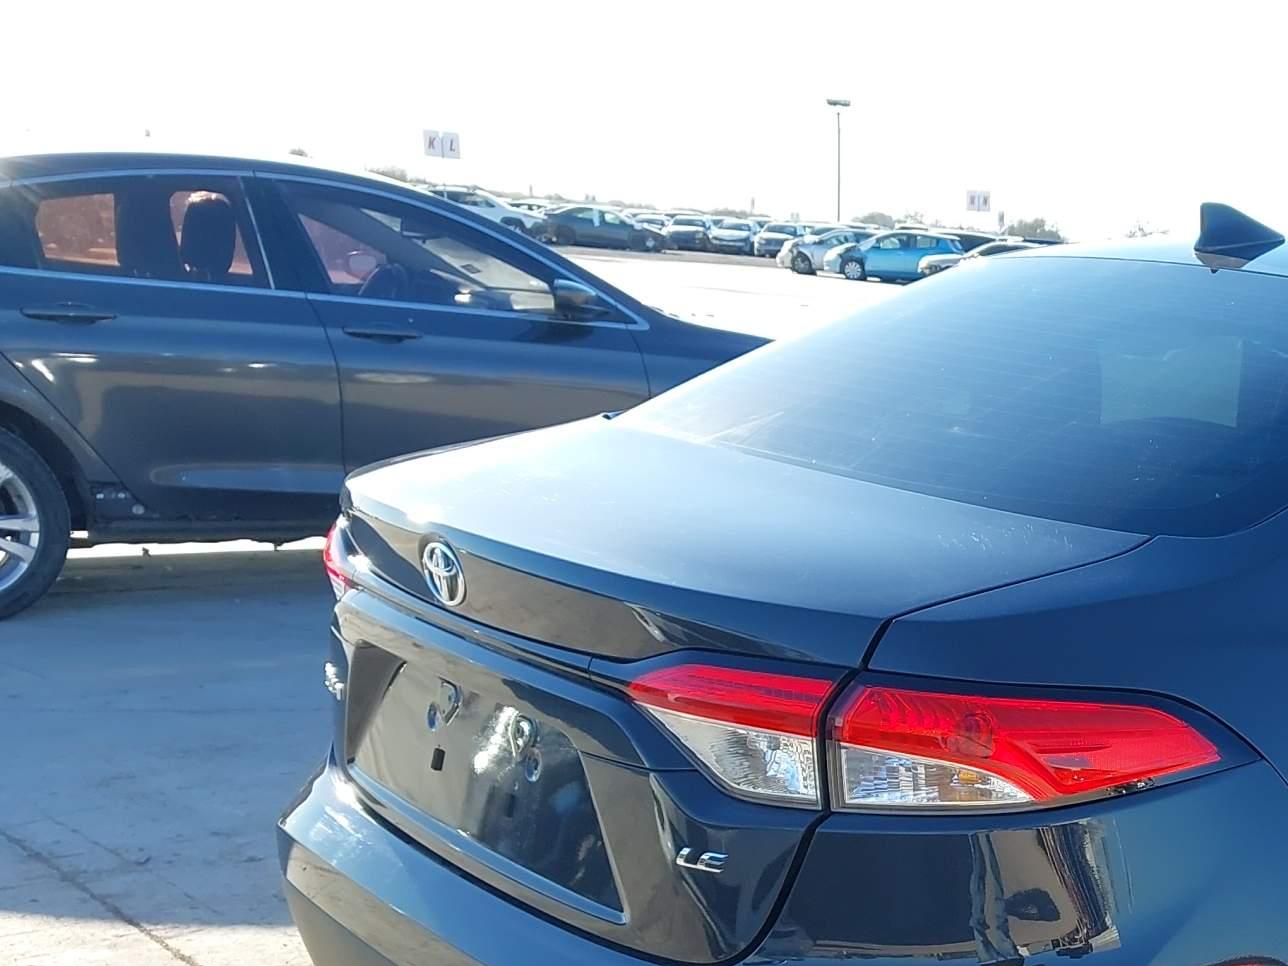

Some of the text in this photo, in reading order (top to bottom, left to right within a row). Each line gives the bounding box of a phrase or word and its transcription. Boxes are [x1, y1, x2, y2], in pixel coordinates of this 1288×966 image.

[428, 136, 456, 152] K L
[676, 847, 728, 873] LE
